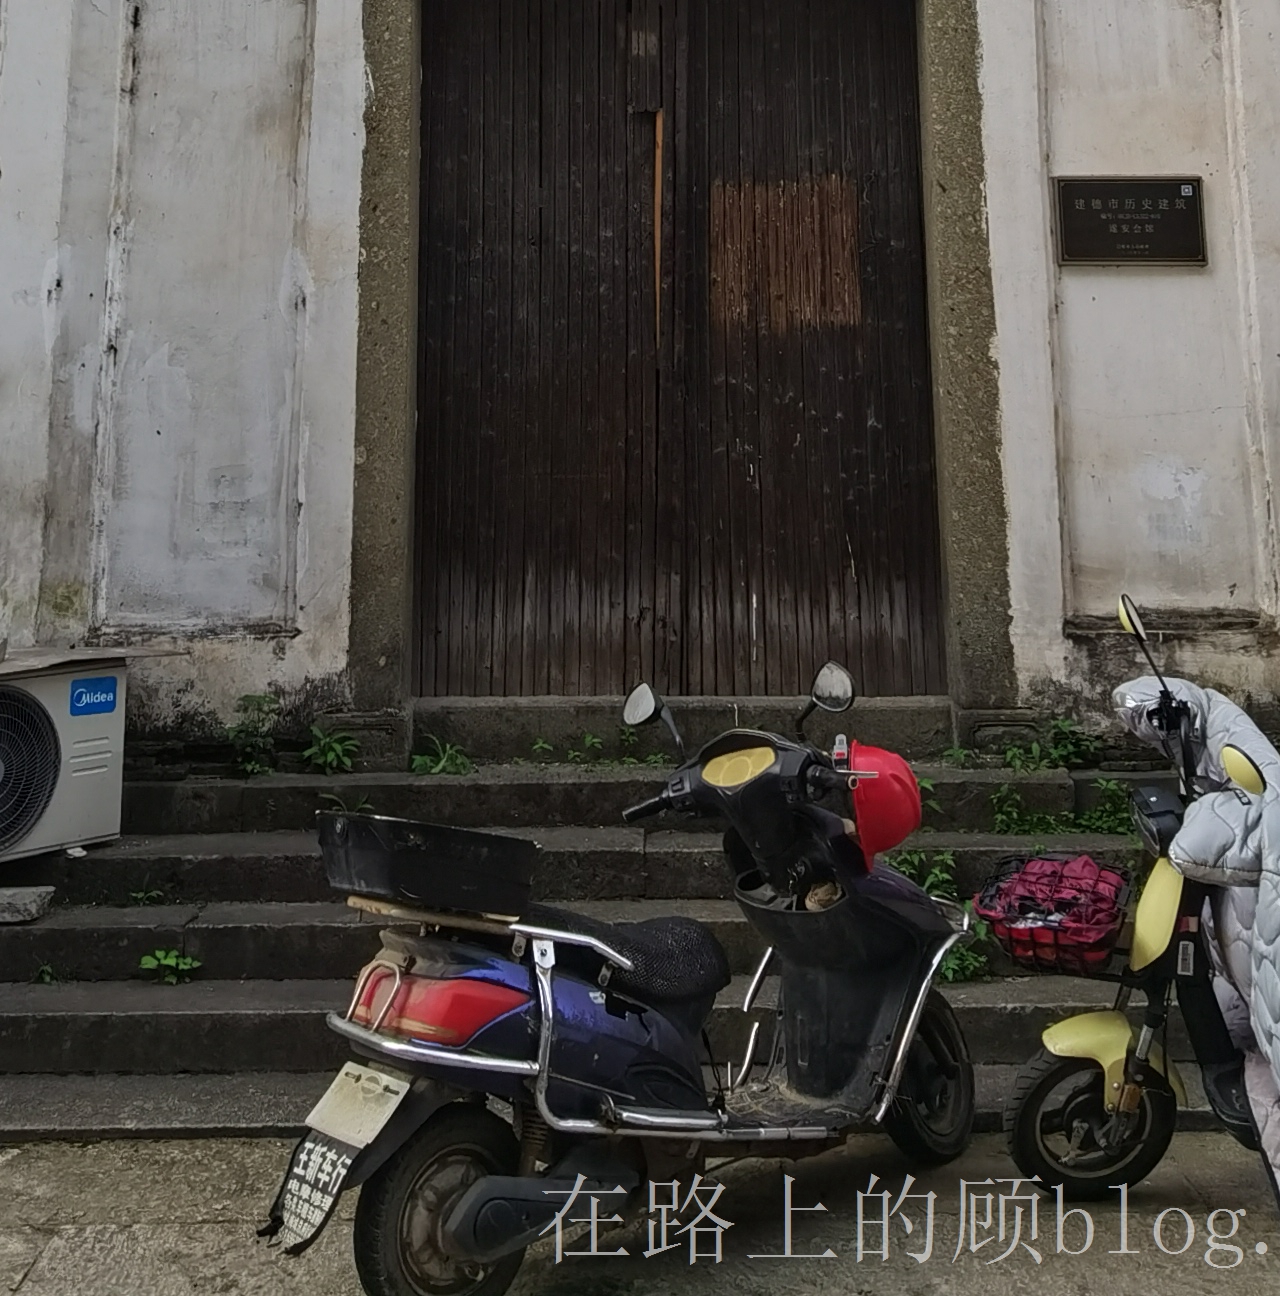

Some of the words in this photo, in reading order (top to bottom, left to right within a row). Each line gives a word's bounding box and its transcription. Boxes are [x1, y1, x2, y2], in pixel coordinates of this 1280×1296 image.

[1074, 198, 1187, 210] 建德市历史建筑
[72, 688, 114, 707] Midea
[293, 1141, 353, 1195] 王新车行
